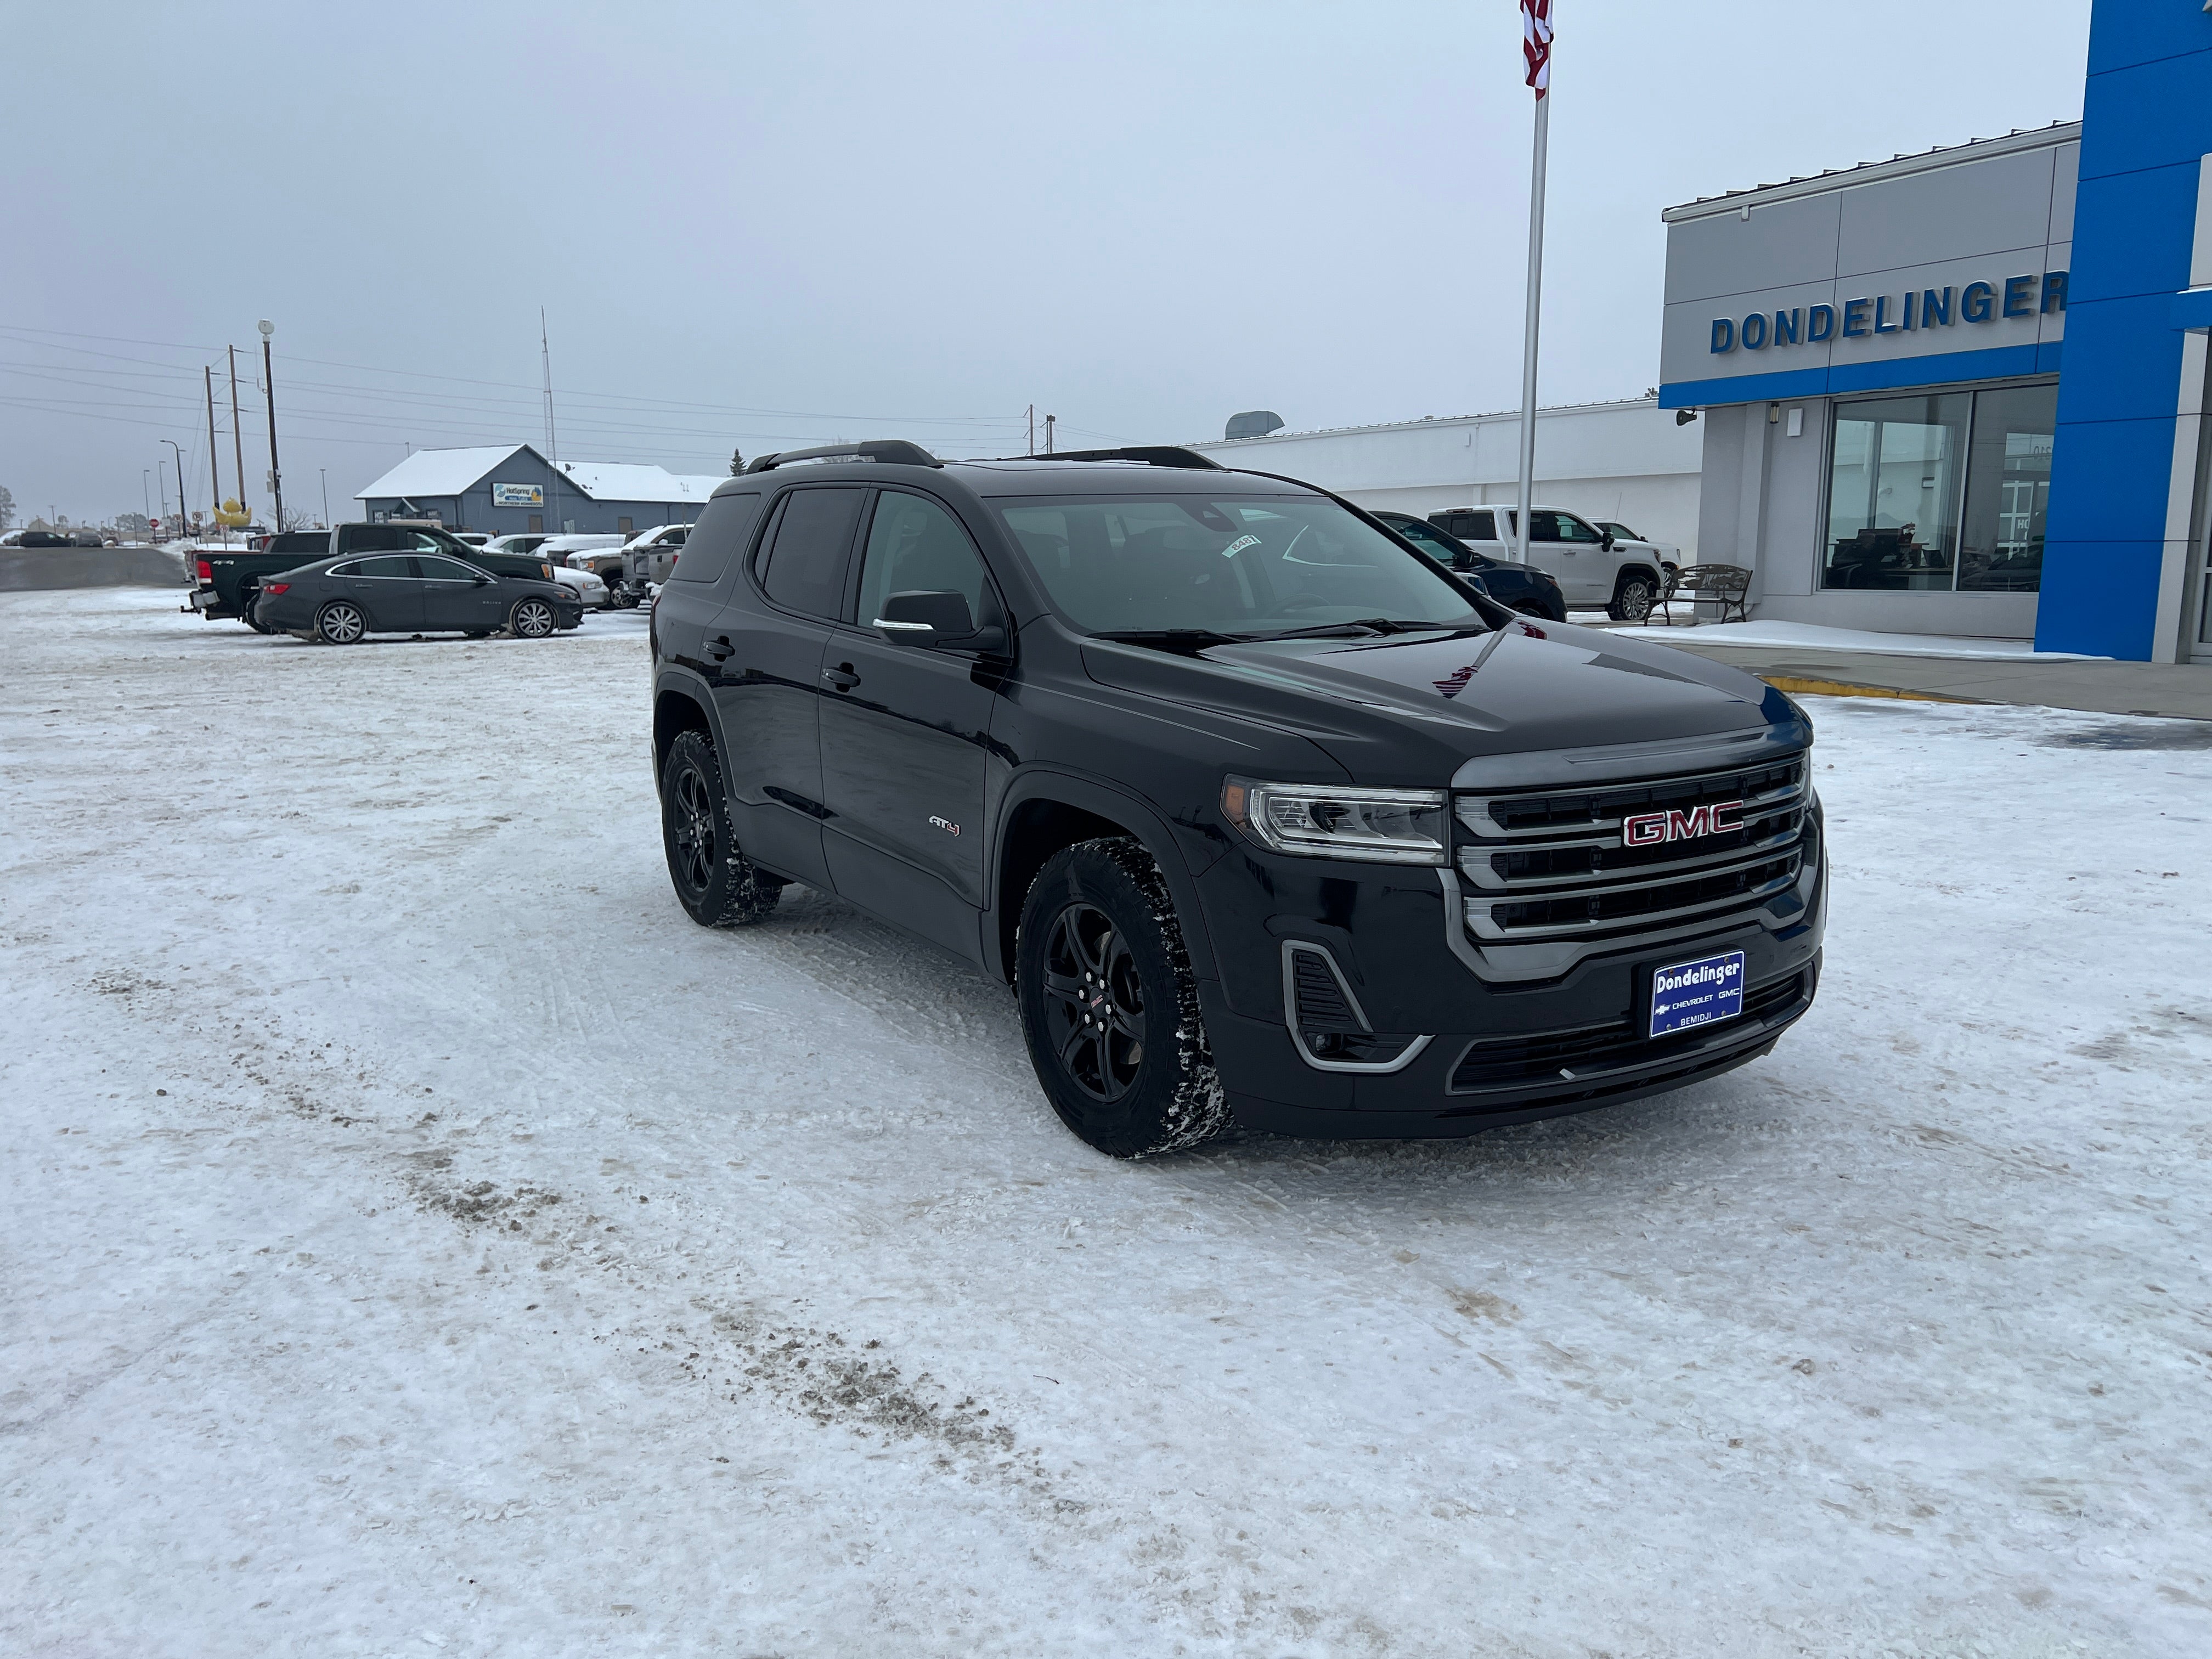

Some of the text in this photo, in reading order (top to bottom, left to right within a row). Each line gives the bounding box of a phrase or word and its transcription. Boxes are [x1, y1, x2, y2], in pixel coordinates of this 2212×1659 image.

[1710, 270, 2069, 354] DONDELINGER
[1232, 536, 1256, 550] 8487
[929, 815, 960, 837] AT4
[1624, 800, 1743, 847] GMC
[1657, 963, 1740, 994] Dondelinger
[1672, 988, 1740, 1009] CHEVROLET GMC
[1680, 1012, 1712, 1026] BEMIDJI
